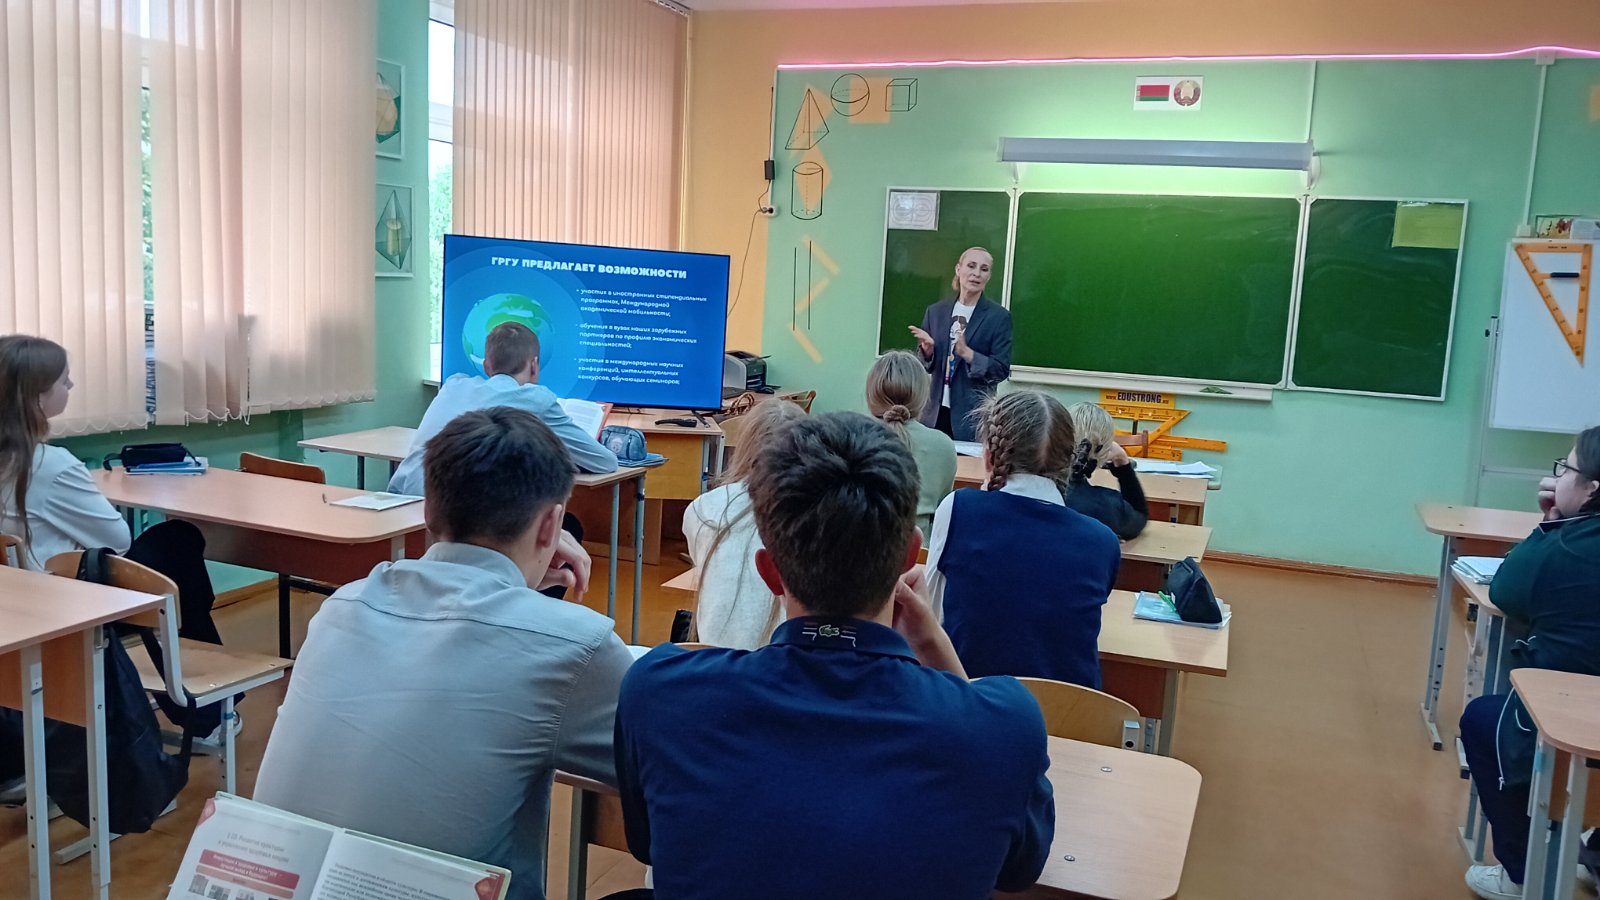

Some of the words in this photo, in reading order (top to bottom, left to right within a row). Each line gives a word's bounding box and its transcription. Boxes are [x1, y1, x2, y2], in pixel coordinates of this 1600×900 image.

[491, 256, 519, 267] ГРГУ
[521, 258, 596, 273] ПРЕДЛАГАЕТ
[598, 264, 687, 279] ВОЗМОЖНОСТИ
[655, 294, 708, 302] стипендиальных
[620, 299, 670, 308] Международной
